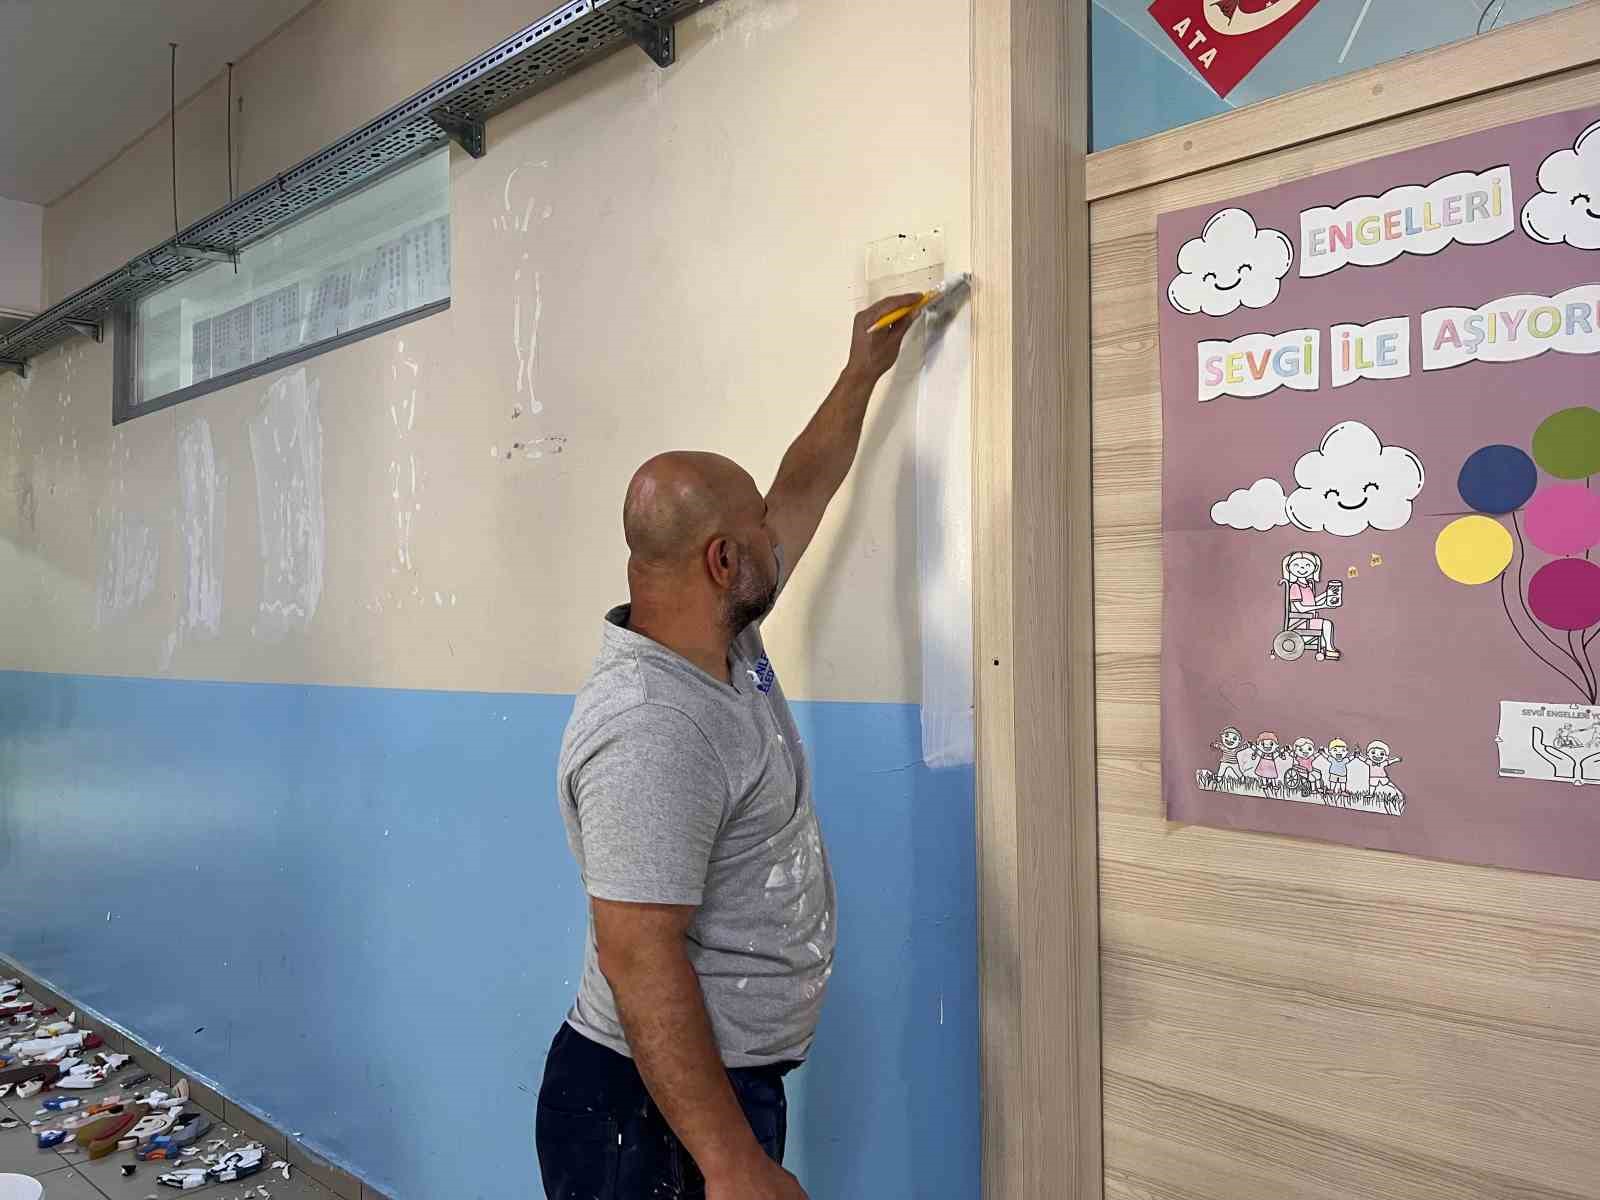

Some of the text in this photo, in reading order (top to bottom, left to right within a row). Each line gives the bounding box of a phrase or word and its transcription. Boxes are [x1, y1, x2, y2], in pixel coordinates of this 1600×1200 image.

[1172, 17, 1218, 69] ATA
[1308, 177, 1502, 257] ENGELLERİ
[1204, 302, 1600, 387] SEVGİ İLE AŞIYOR
